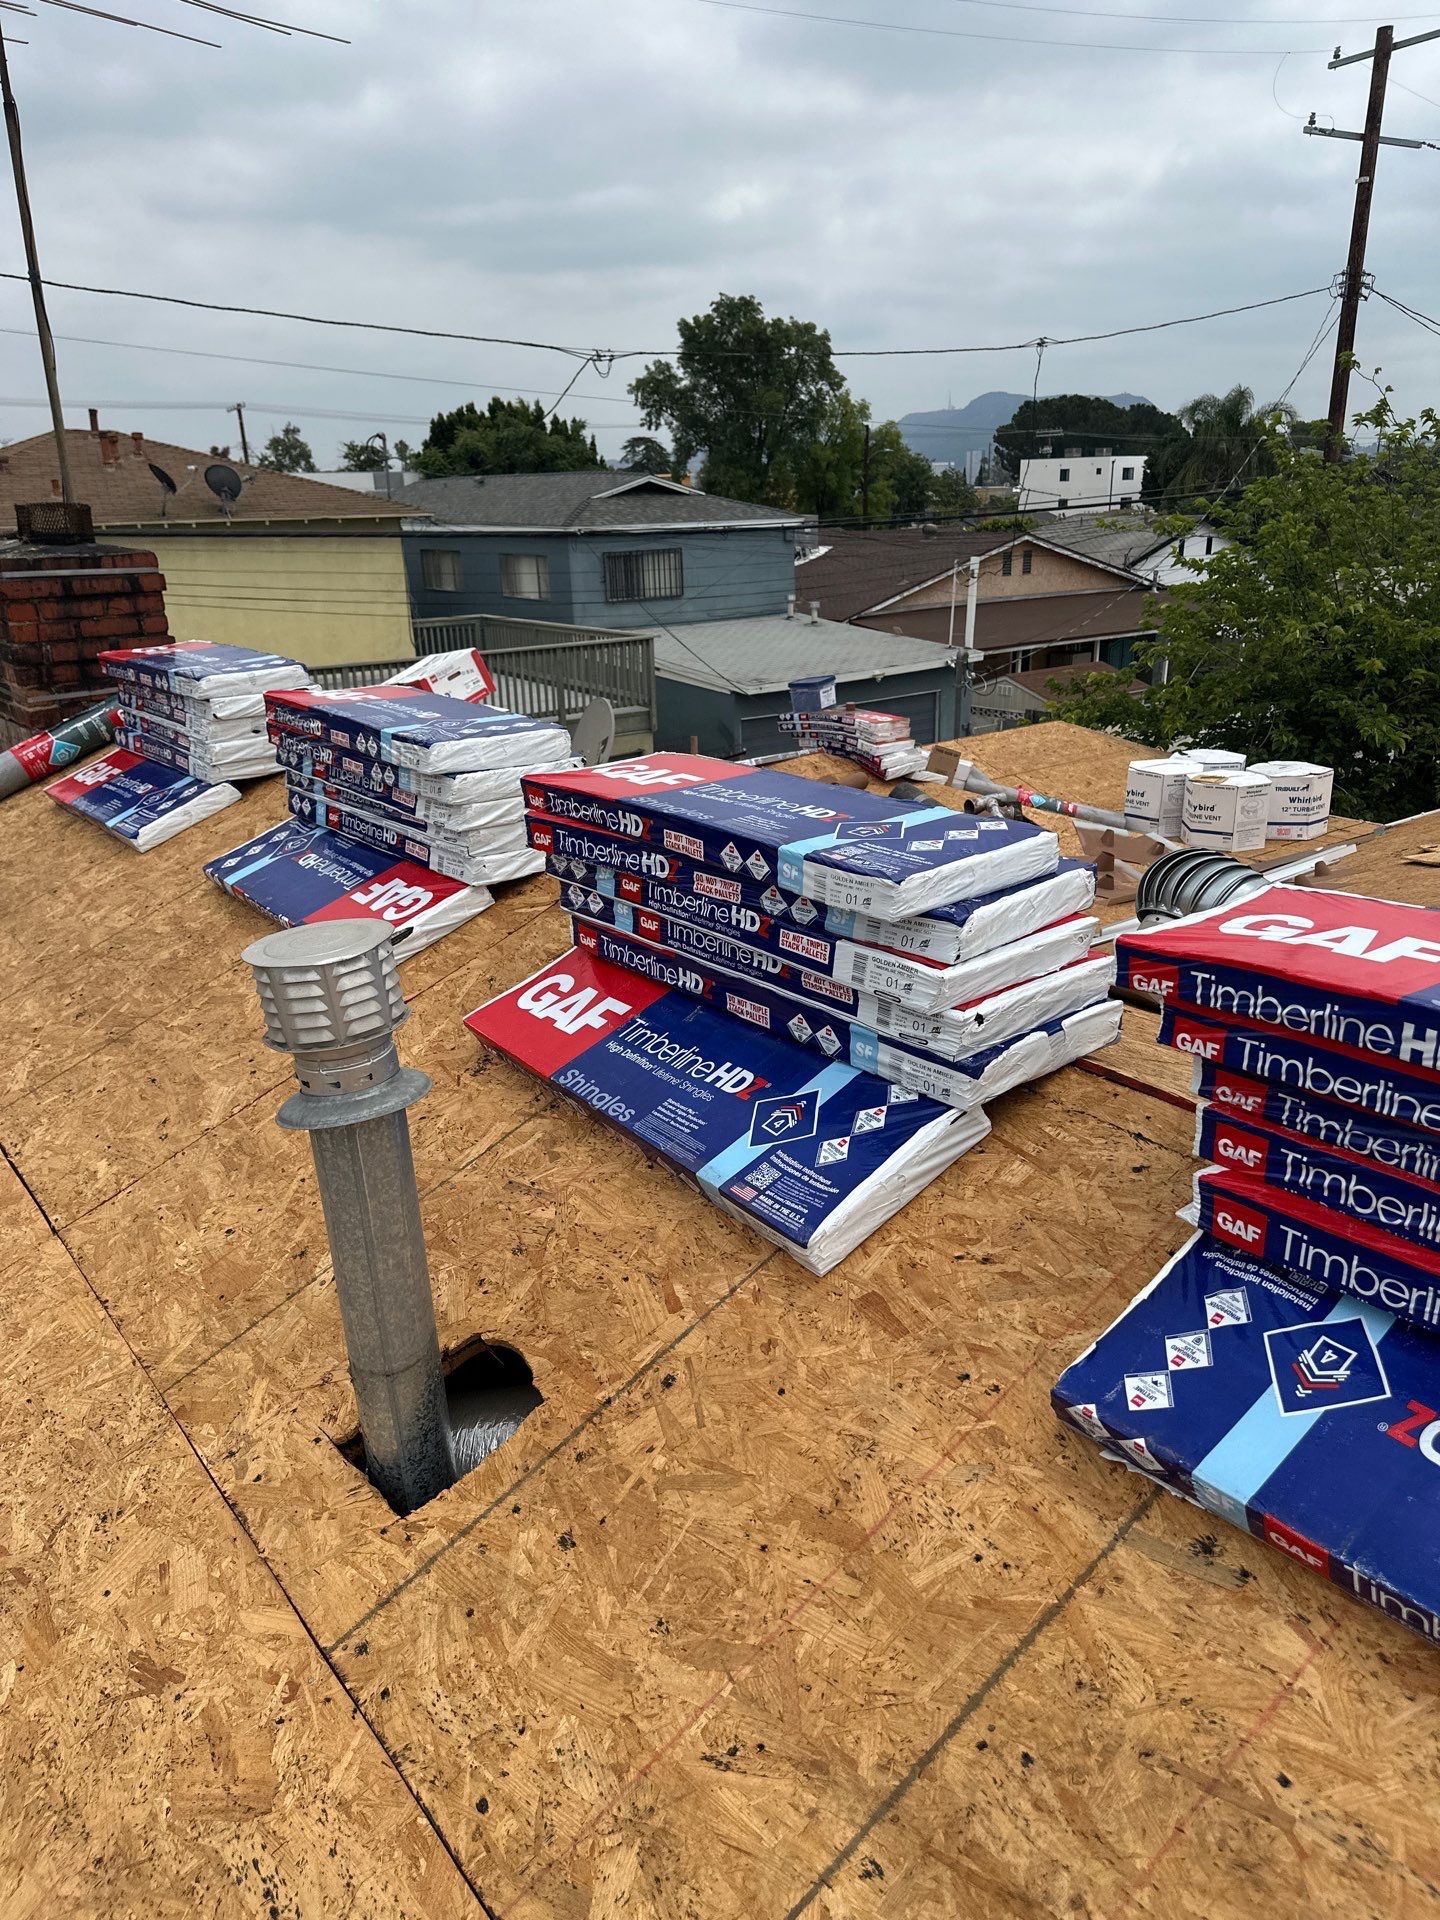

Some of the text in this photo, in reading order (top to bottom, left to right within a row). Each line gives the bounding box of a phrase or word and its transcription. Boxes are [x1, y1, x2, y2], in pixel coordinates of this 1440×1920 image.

[592, 764, 705, 786] GAF
[529, 792, 653, 843] GAF TimberlineHDZ
[665, 841, 703, 860] STACK PALLETS
[674, 833, 684, 842] NOT
[685, 836, 702, 849] TRIPLE
[534, 829, 680, 881] GAF TimberlineHDZ
[782, 863, 799, 880] SF
[695, 883, 739, 902] STACK PALLETS
[705, 877, 717, 886] NOT
[720, 880, 739, 893] TRIPLE
[350, 877, 434, 921] GAF
[622, 879, 771, 939] GAF TimberlineHDZ
[846, 893, 857, 905] 01
[617, 905, 629, 916] SF
[648, 900, 661, 911] High
[716, 922, 741, 938] Shingles
[640, 916, 659, 931] GAF
[668, 939, 680, 949] High
[781, 932, 828, 952] DO NOT TRIPLE
[901, 935, 914, 948] 01
[1219, 914, 1440, 963] GAF
[781, 940, 827, 962] STACK PALLETS
[579, 933, 715, 999] GAF TimberlineHDZ
[871, 956, 919, 974] GOLDEN AMBER
[813, 976, 826, 986] NOT
[829, 981, 850, 993] TRIPLE
[886, 976, 898, 989] 01
[517, 973, 633, 1035] GAF
[750, 1002, 768, 1016] TRIPLE
[728, 1003, 769, 1026] STACK PALLETS
[1132, 970, 1440, 1070] GAF TimberlineH
[913, 1020, 926, 1033] 01
[856, 1042, 872, 1059] SF
[1176, 1032, 1220, 1060] GAF
[618, 1018, 770, 1100] TimberlineHDZ
[606, 1040, 714, 1102] High Definition Lifetime Shingles
[558, 1068, 637, 1123] Shingles
[923, 1080, 936, 1094] 01
[1215, 1086, 1262, 1112] GAF
[1217, 1138, 1440, 1243] GAF Timberli
[758, 1195, 774, 1206] MADE
[779, 1207, 791, 1216] THE
[1216, 1212, 1262, 1243] GAF
[1202, 1250, 1246, 1269] instalación
[1246, 1263, 1259, 1272] de
[1214, 1260, 1313, 1312] Installation instructions
[1171, 1344, 1201, 1364] STAINGUARD
[1184, 1345, 1196, 1355] PLUS
[1269, 1531, 1322, 1567] GAF
